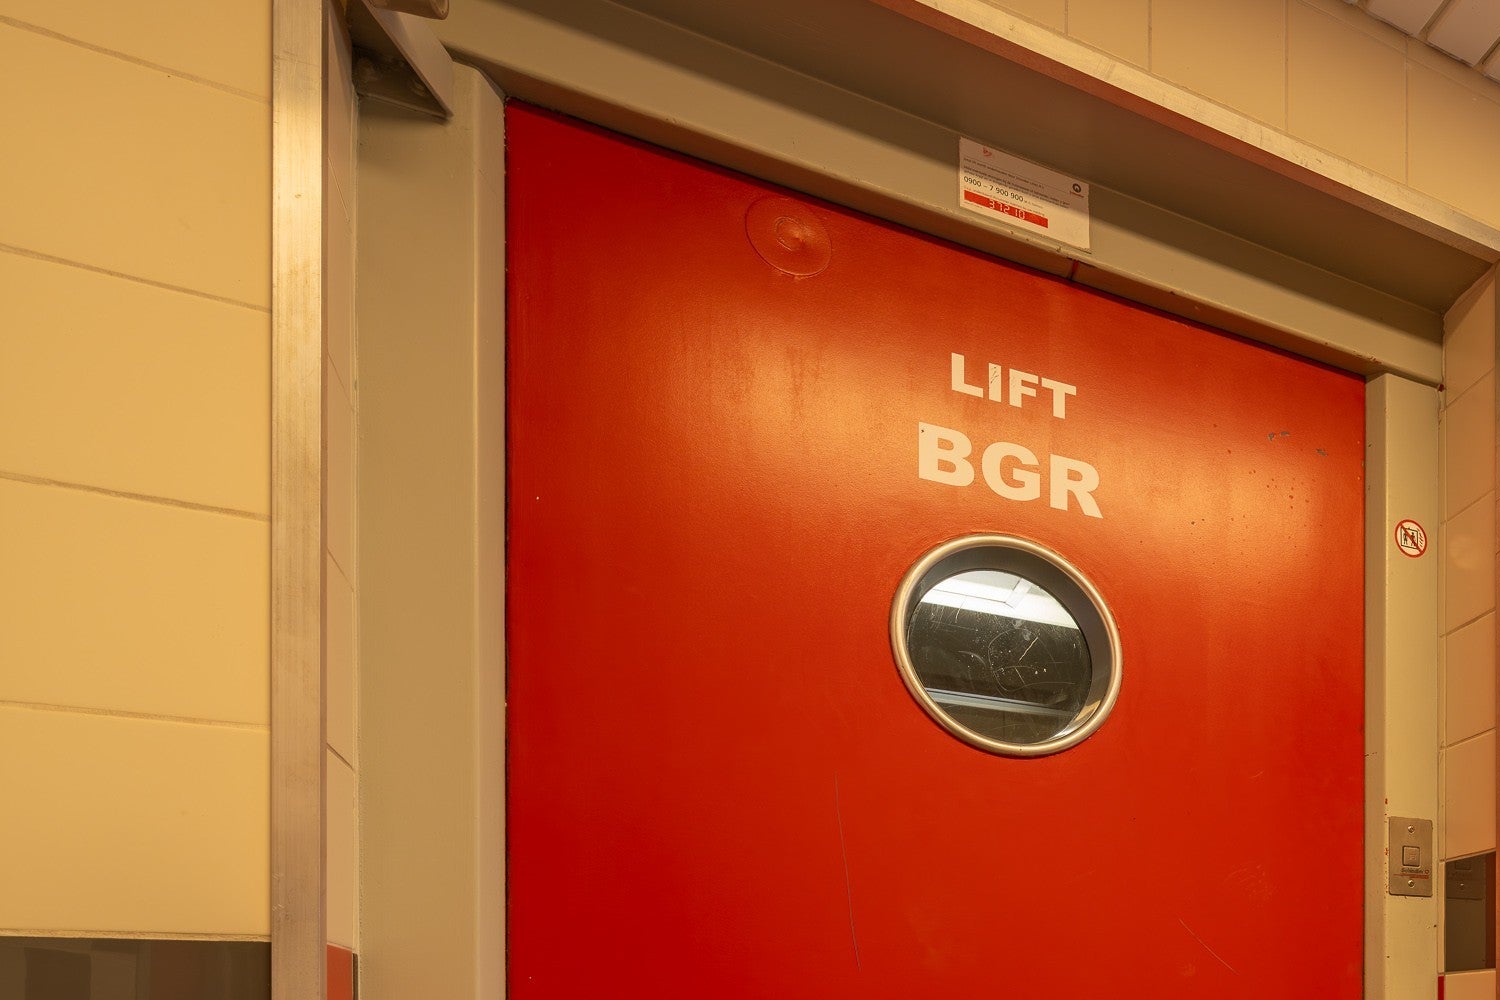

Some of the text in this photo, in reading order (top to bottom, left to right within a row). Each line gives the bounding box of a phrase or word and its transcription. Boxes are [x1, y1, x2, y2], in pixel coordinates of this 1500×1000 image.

[964, 176, 982, 187] 0900
[996, 188, 1008, 197] 900
[1010, 192, 1023, 202] 900
[951, 352, 1077, 420] LIFT
[918, 421, 1104, 519] BGR
